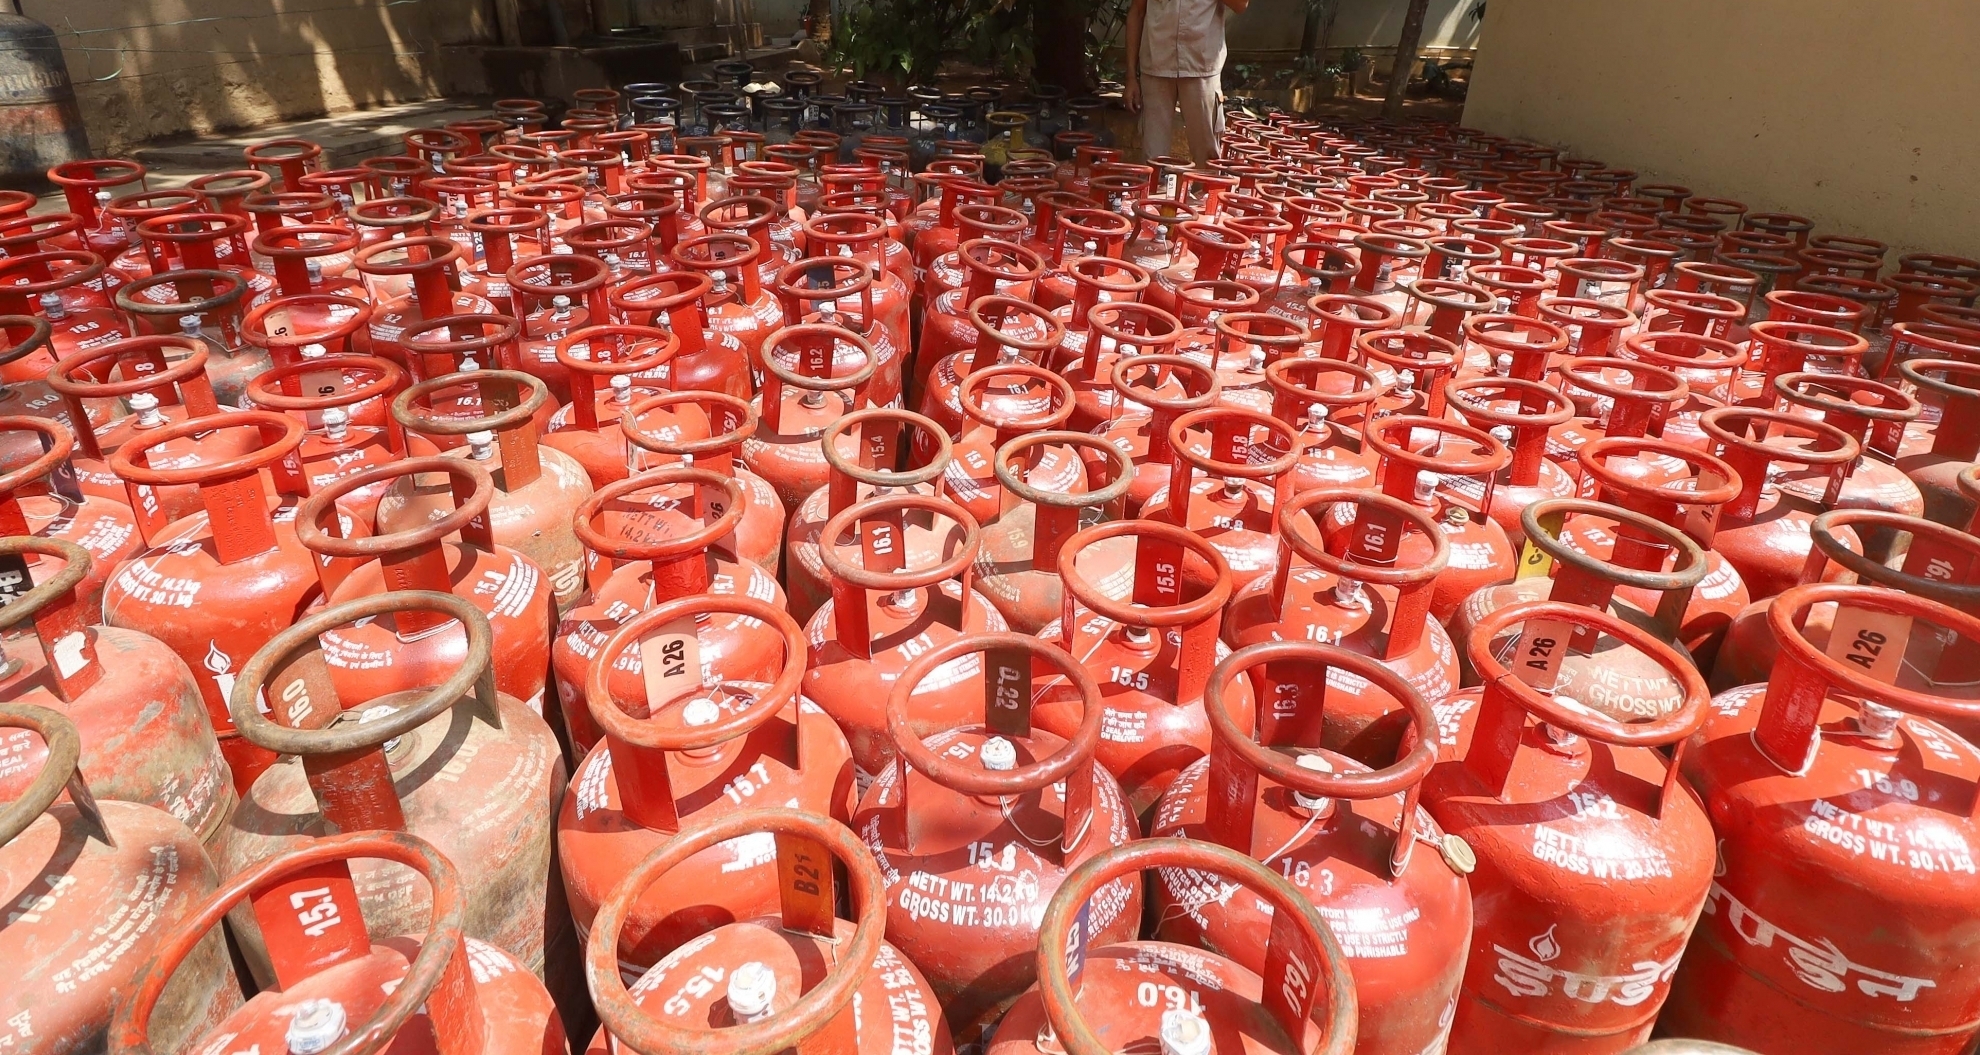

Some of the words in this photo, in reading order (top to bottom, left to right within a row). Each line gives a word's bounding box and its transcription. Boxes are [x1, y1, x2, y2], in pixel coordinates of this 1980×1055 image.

[70, 321, 100, 334] 15.6
[987, 315, 998, 328] 6.1
[1122, 320, 1136, 335] 5.7
[26, 394, 60, 410] 16.0
[870, 436, 885, 459] 15.4
[1231, 435, 1248, 460] 15.8
[1213, 515, 1244, 531] 15.8
[871, 526, 893, 555] 16.1
[1363, 523, 1387, 553] 16.1
[1156, 563, 1175, 594] 15.5
[1924, 558, 1955, 582] 16.
[603, 601, 640, 626] 15.7
[896, 633, 934, 661] 16.1
[1306, 624, 1343, 647] 16.1
[1846, 629, 1887, 670] A26
[662, 639, 686, 679] A26
[1110, 666, 1150, 690] 15.5
[1325, 677, 1363, 697] UNISHABLE
[723, 762, 771, 805] 15.7
[1854, 768, 1919, 802] 15.9
[1810, 797, 1863, 830] NETT
[1530, 840, 1590, 876] GROSS
[1804, 815, 1866, 856] GROSS
[1868, 834, 1907, 866] WT.
[1907, 848, 1950, 873] 30.1
[907, 868, 948, 901] NETT
[949, 879, 977, 904] WT.
[1282, 857, 1334, 897] 16.3
[898, 886, 950, 926] GROSS
[951, 903, 981, 929] WT.
[982, 902, 1020, 929] 30.0
[1370, 928, 1409, 944] STRICTLY
[668, 965, 725, 1016] 15.5
